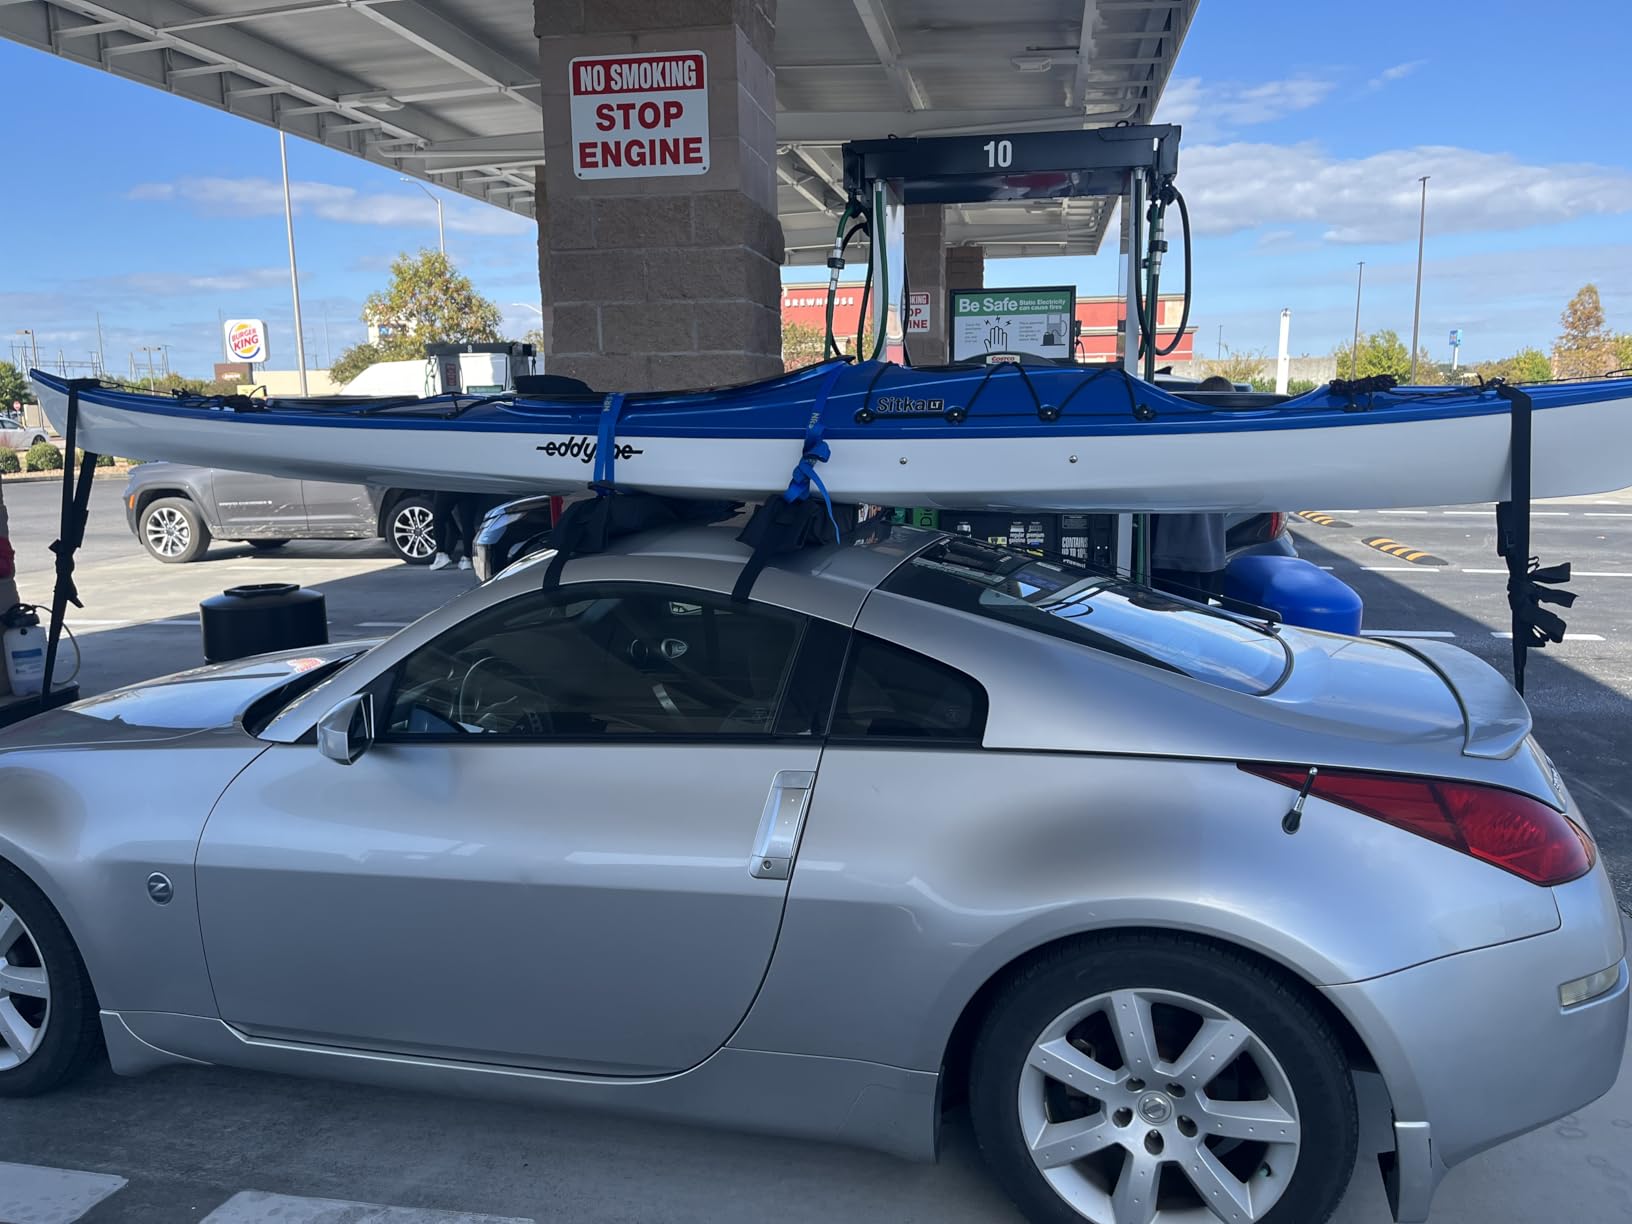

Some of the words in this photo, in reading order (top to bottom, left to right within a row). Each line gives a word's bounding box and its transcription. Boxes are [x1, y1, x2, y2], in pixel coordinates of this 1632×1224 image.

[579, 64, 605, 92] NO
[609, 60, 697, 91] SMOKING
[595, 100, 684, 132] STOP
[578, 136, 704, 169] ENGINE
[983, 140, 1013, 168] 10
[784, 297, 855, 307] BREWHUSE
[959, 298, 980, 312] Be
[982, 297, 1018, 312] Safe
[231, 328, 257, 342] BURGER
[233, 334, 259, 351] KING
[876, 396, 927, 413] Sitka
[1061, 536, 1089, 548] CONTAINS
